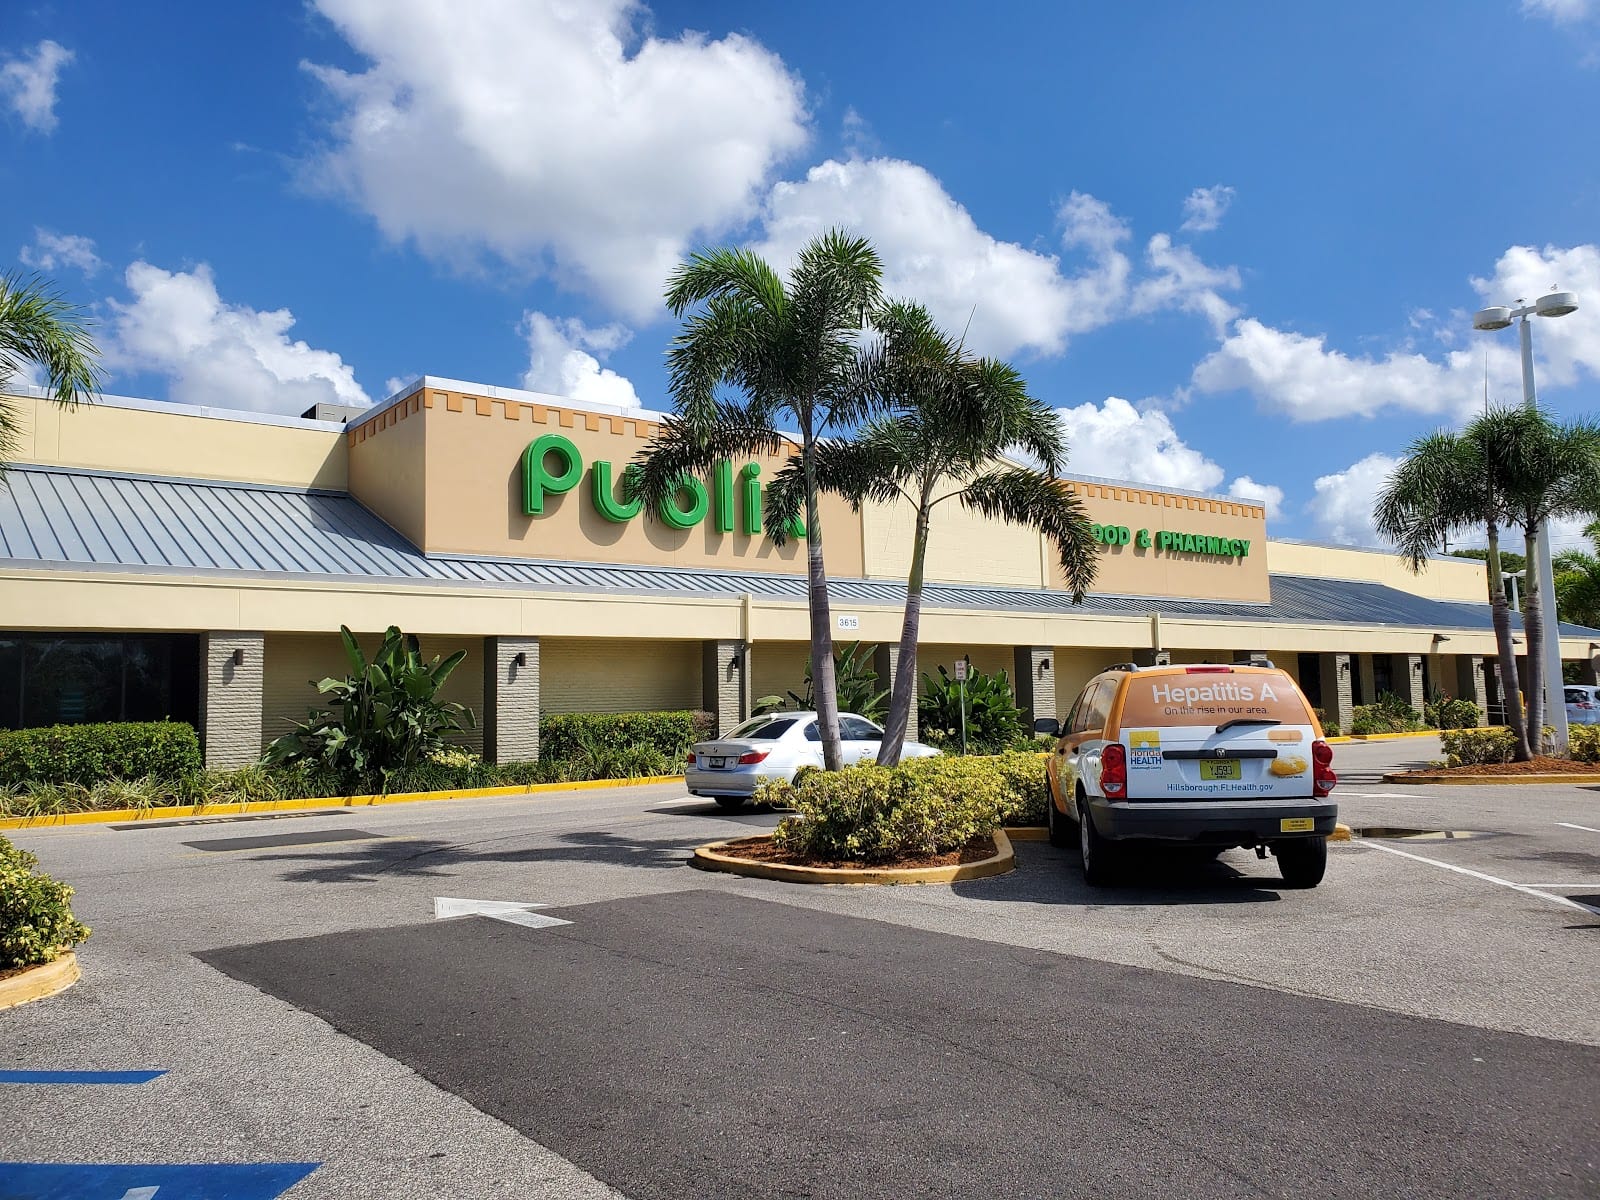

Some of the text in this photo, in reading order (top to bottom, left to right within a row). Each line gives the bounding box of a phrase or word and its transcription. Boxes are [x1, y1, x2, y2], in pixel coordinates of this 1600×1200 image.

[1078, 522, 1251, 557] OOD & PHARMACY
[839, 618, 857, 627] 3615
[1152, 682, 1279, 707] Hepatitis A
[1164, 705, 1270, 716] On the rise in our area.
[1130, 749, 1161, 757] Florida
[1130, 756, 1162, 765] HEALTH
